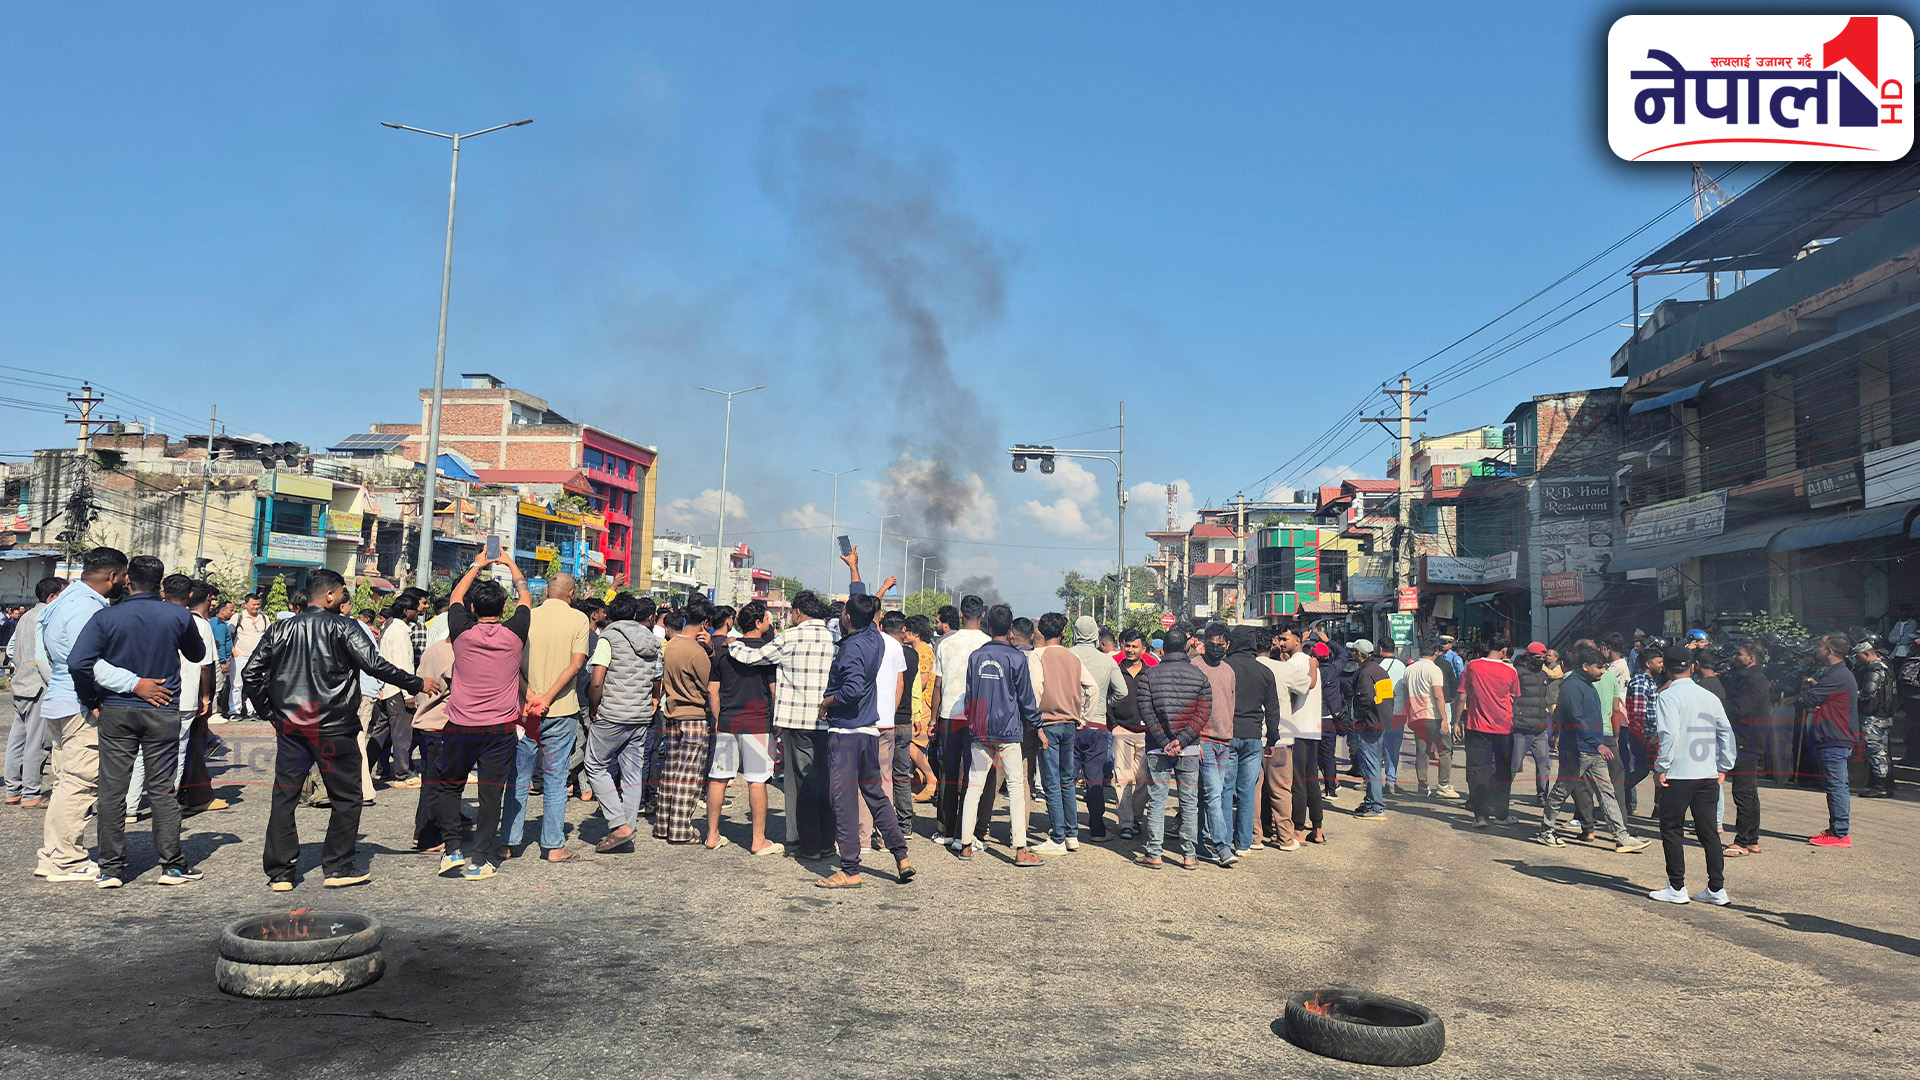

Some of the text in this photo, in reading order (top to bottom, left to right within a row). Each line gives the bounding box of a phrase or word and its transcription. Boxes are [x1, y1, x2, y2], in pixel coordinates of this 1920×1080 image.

[1541, 485, 1610, 501] R.B. Hotel
[1544, 501, 1608, 515] Restaurant
